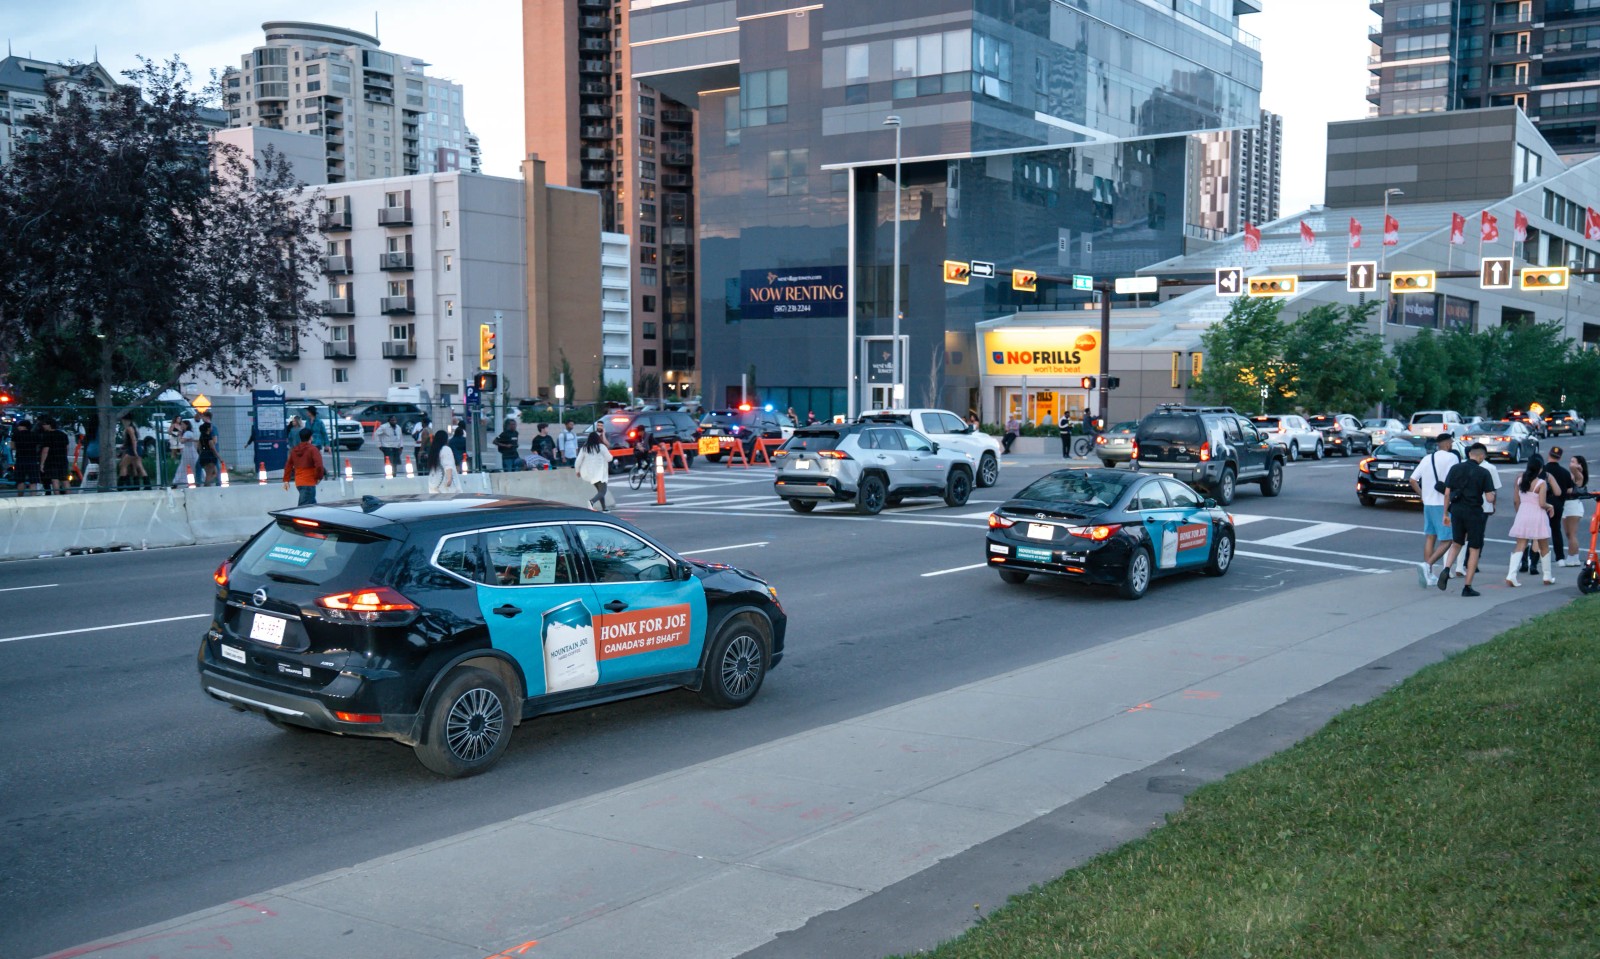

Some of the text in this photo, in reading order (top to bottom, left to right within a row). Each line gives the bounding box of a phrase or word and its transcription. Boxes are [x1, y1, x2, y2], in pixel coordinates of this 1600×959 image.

[750, 285, 844, 302] NOW RENTING
[1053, 365, 1063, 373] be
[1064, 365, 1081, 373] beat
[600, 613, 687, 641] HONK FOR JOE
[550, 637, 588, 658] MOUNTAIN JOE
[604, 632, 682, 654] CANADA'S #1 SHAFT
